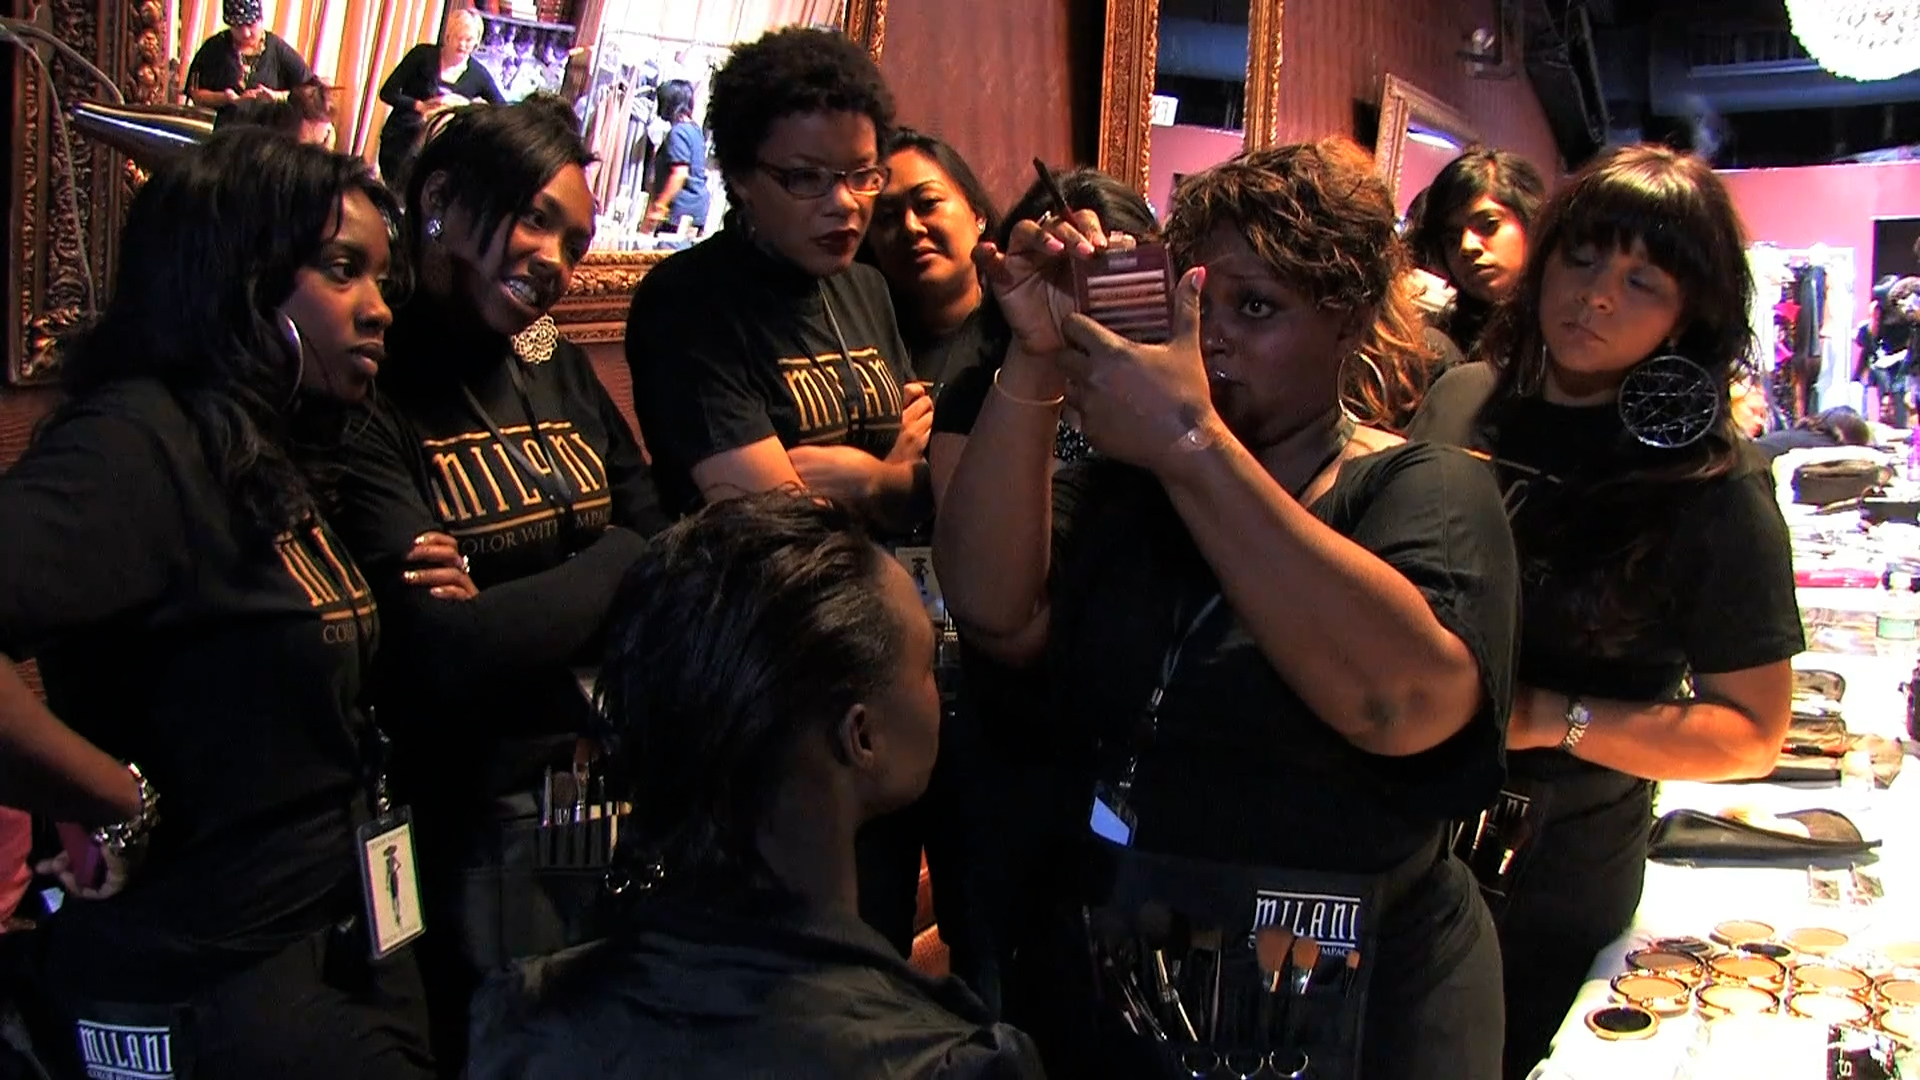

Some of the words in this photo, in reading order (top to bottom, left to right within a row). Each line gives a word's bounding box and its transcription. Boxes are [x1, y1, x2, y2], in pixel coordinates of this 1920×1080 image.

[461, 531, 518, 556] OLOR
[1250, 897, 1360, 942] MILANI
[78, 1026, 173, 1073] MILANI
